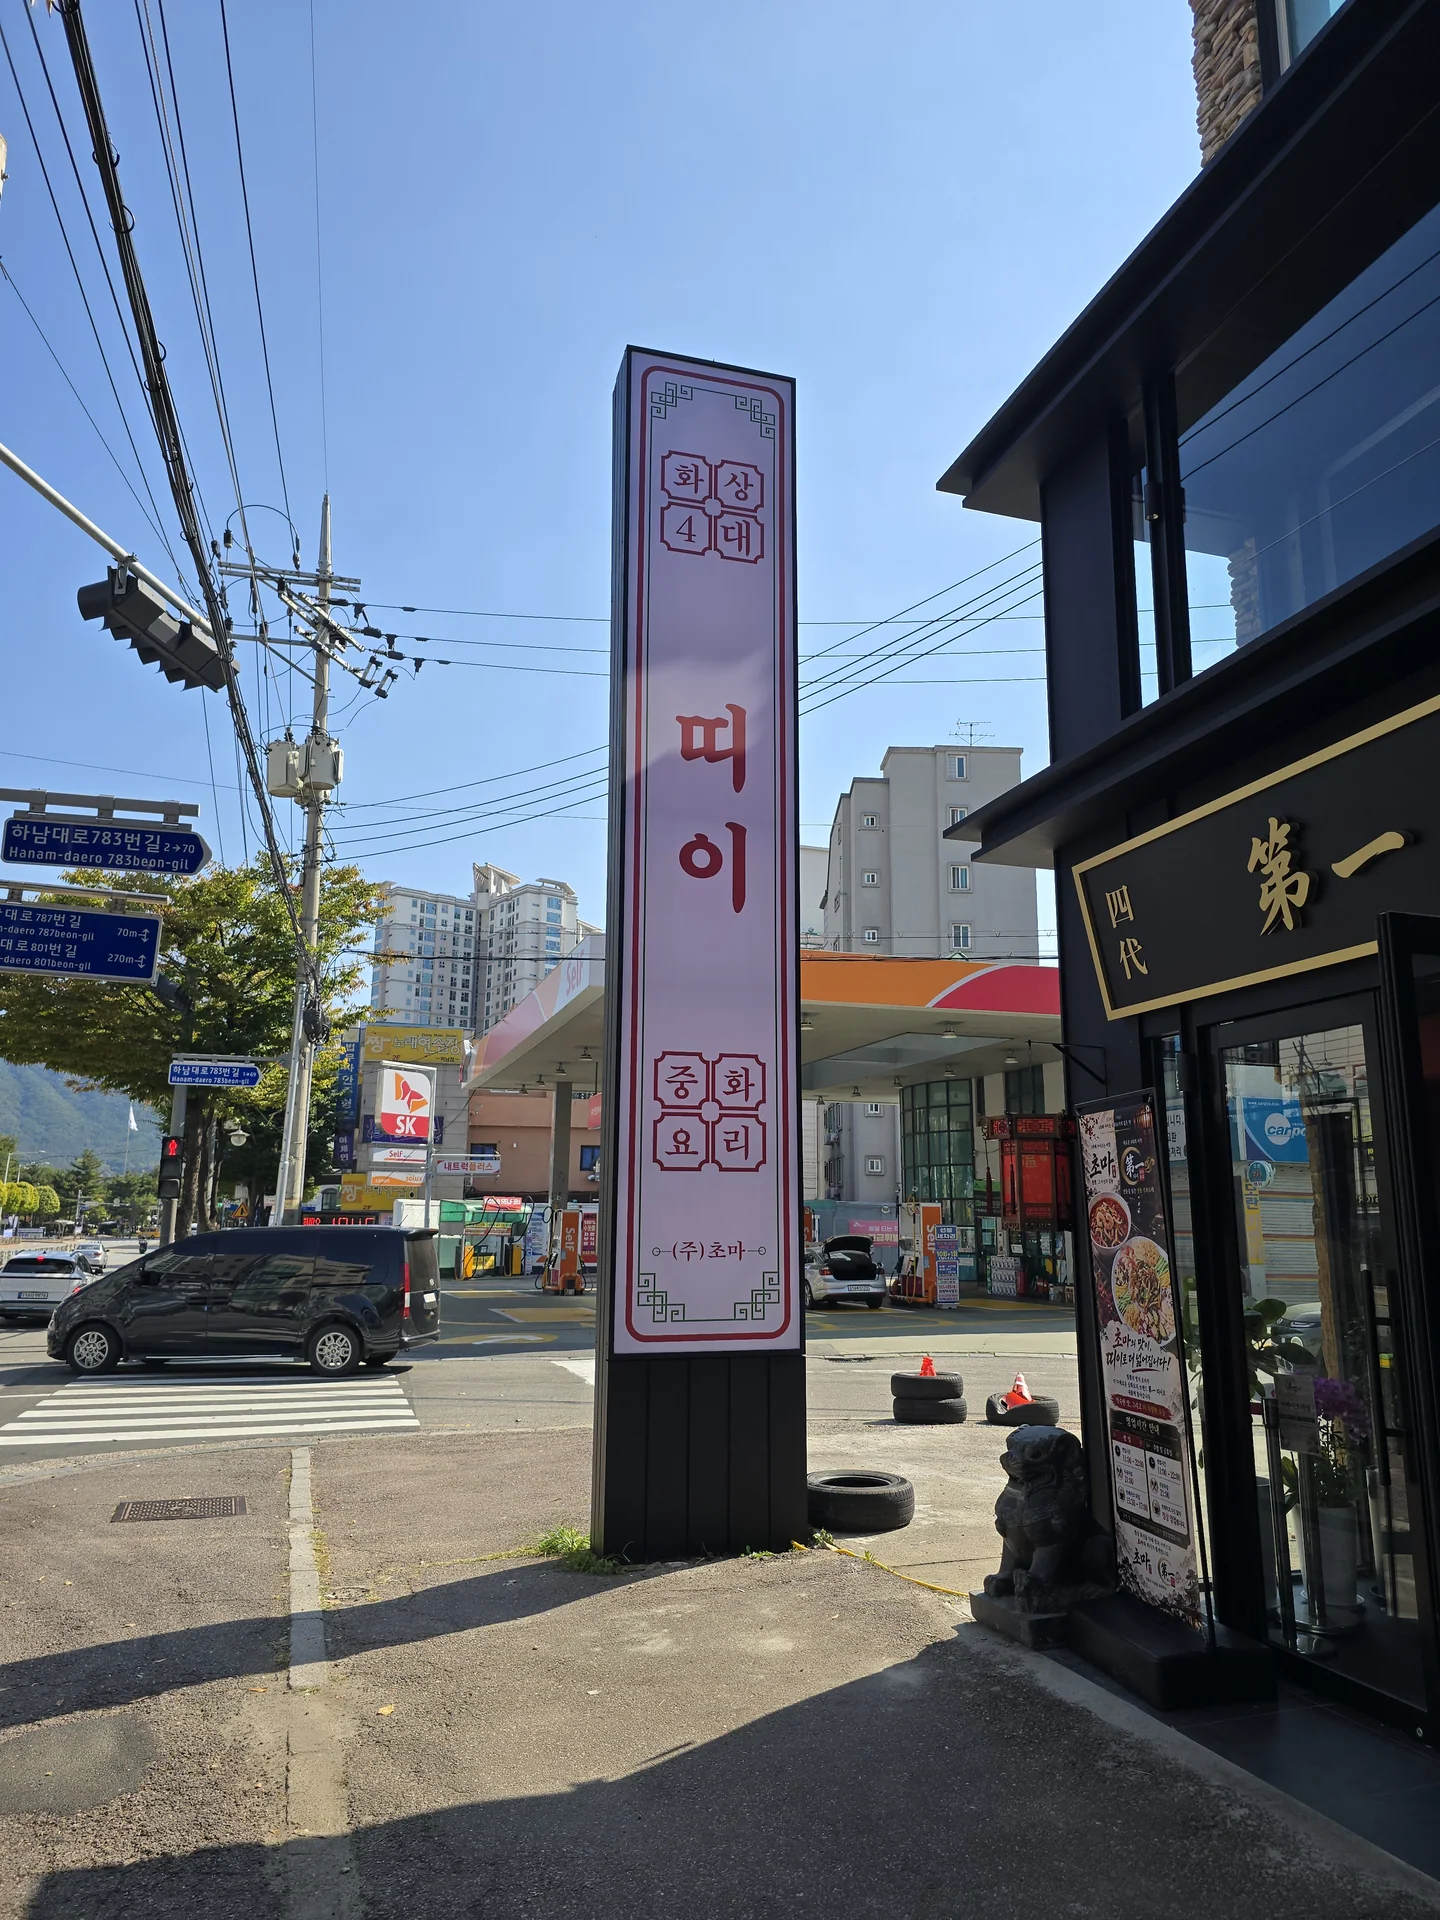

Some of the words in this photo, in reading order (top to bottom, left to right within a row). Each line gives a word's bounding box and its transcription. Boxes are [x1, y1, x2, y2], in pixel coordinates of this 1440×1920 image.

[673, 463, 754, 502] 화상
[676, 515, 750, 556] 4대
[12, 824, 161, 853] 하남대로783번길
[9, 847, 103, 864] Hanam-daero
[107, 853, 189, 872] 783beon-gil
[38, 928, 95, 942] 787beon-gil
[117, 928, 137, 938] 70m
[34, 957, 91, 971] 801beon-gil
[107, 953, 134, 964] 270m
[665, 1066, 755, 1102] 중화
[395, 1116, 417, 1135] SK
[389, 1150, 403, 1158] Self
[665, 1125, 749, 1161] 요리
[444, 1162, 493, 1171] 내트럭플러스
[565, 1227, 575, 1252] Self
